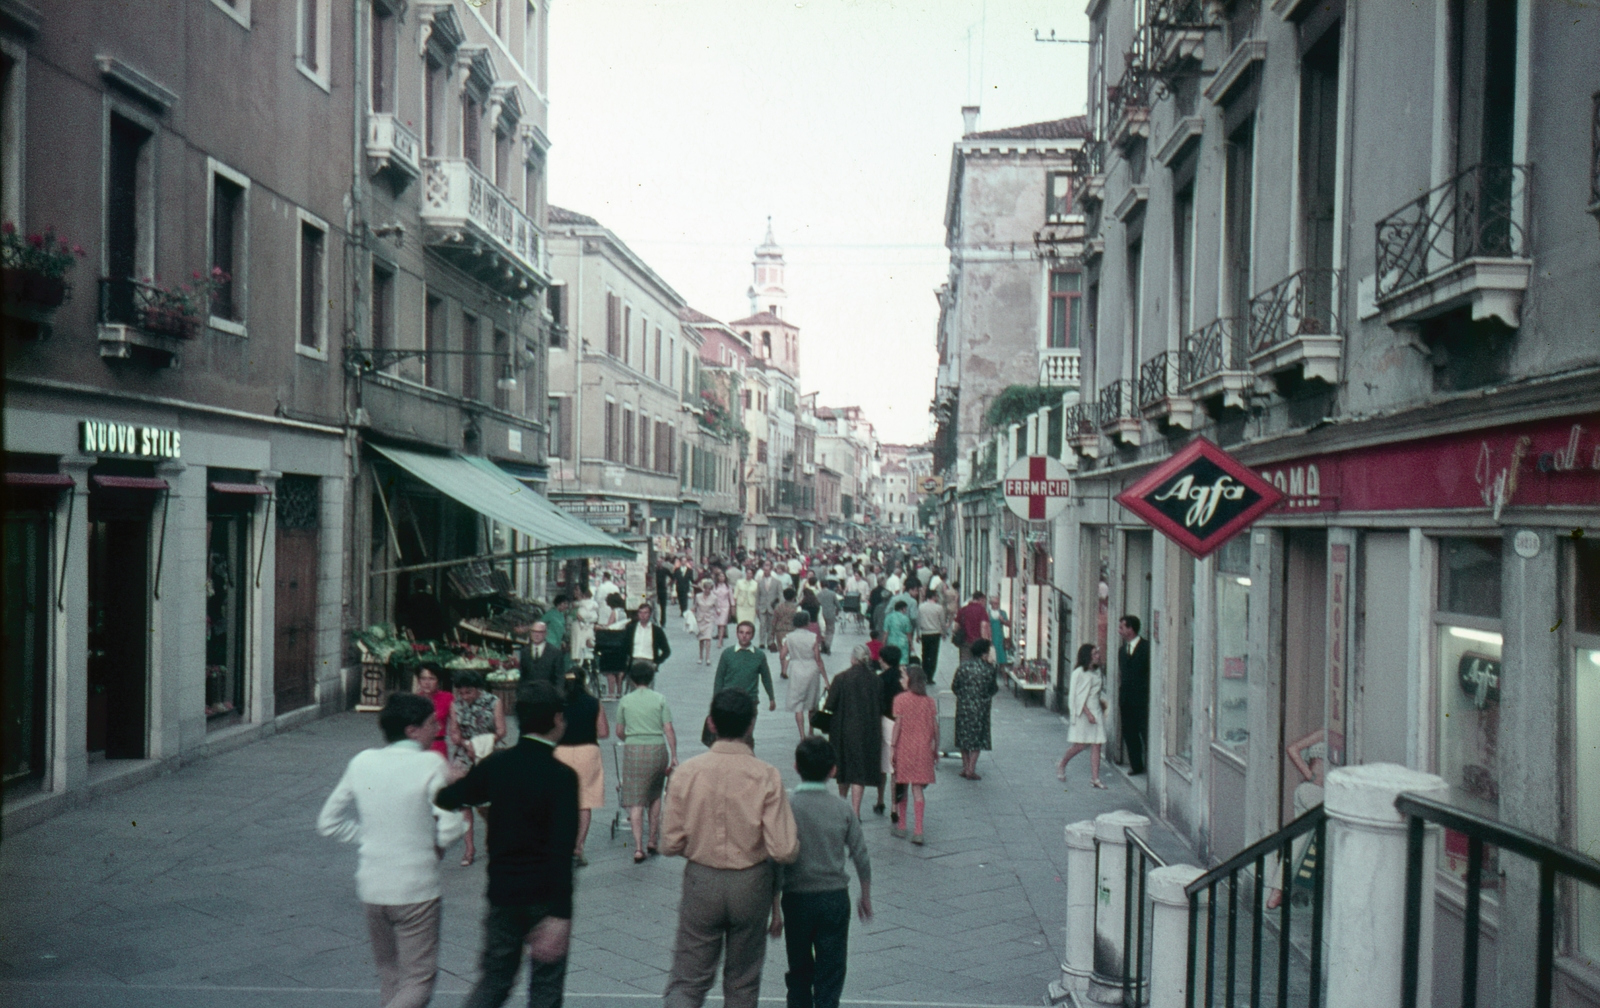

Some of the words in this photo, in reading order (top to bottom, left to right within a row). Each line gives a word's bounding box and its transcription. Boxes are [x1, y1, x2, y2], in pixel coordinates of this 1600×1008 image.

[86, 420, 135, 454] NUOVO
[142, 427, 181, 458] STILE
[1007, 480, 1068, 496] FARMACIA
[1154, 474, 1246, 527] Agfa
[1261, 464, 1320, 507] OMA
